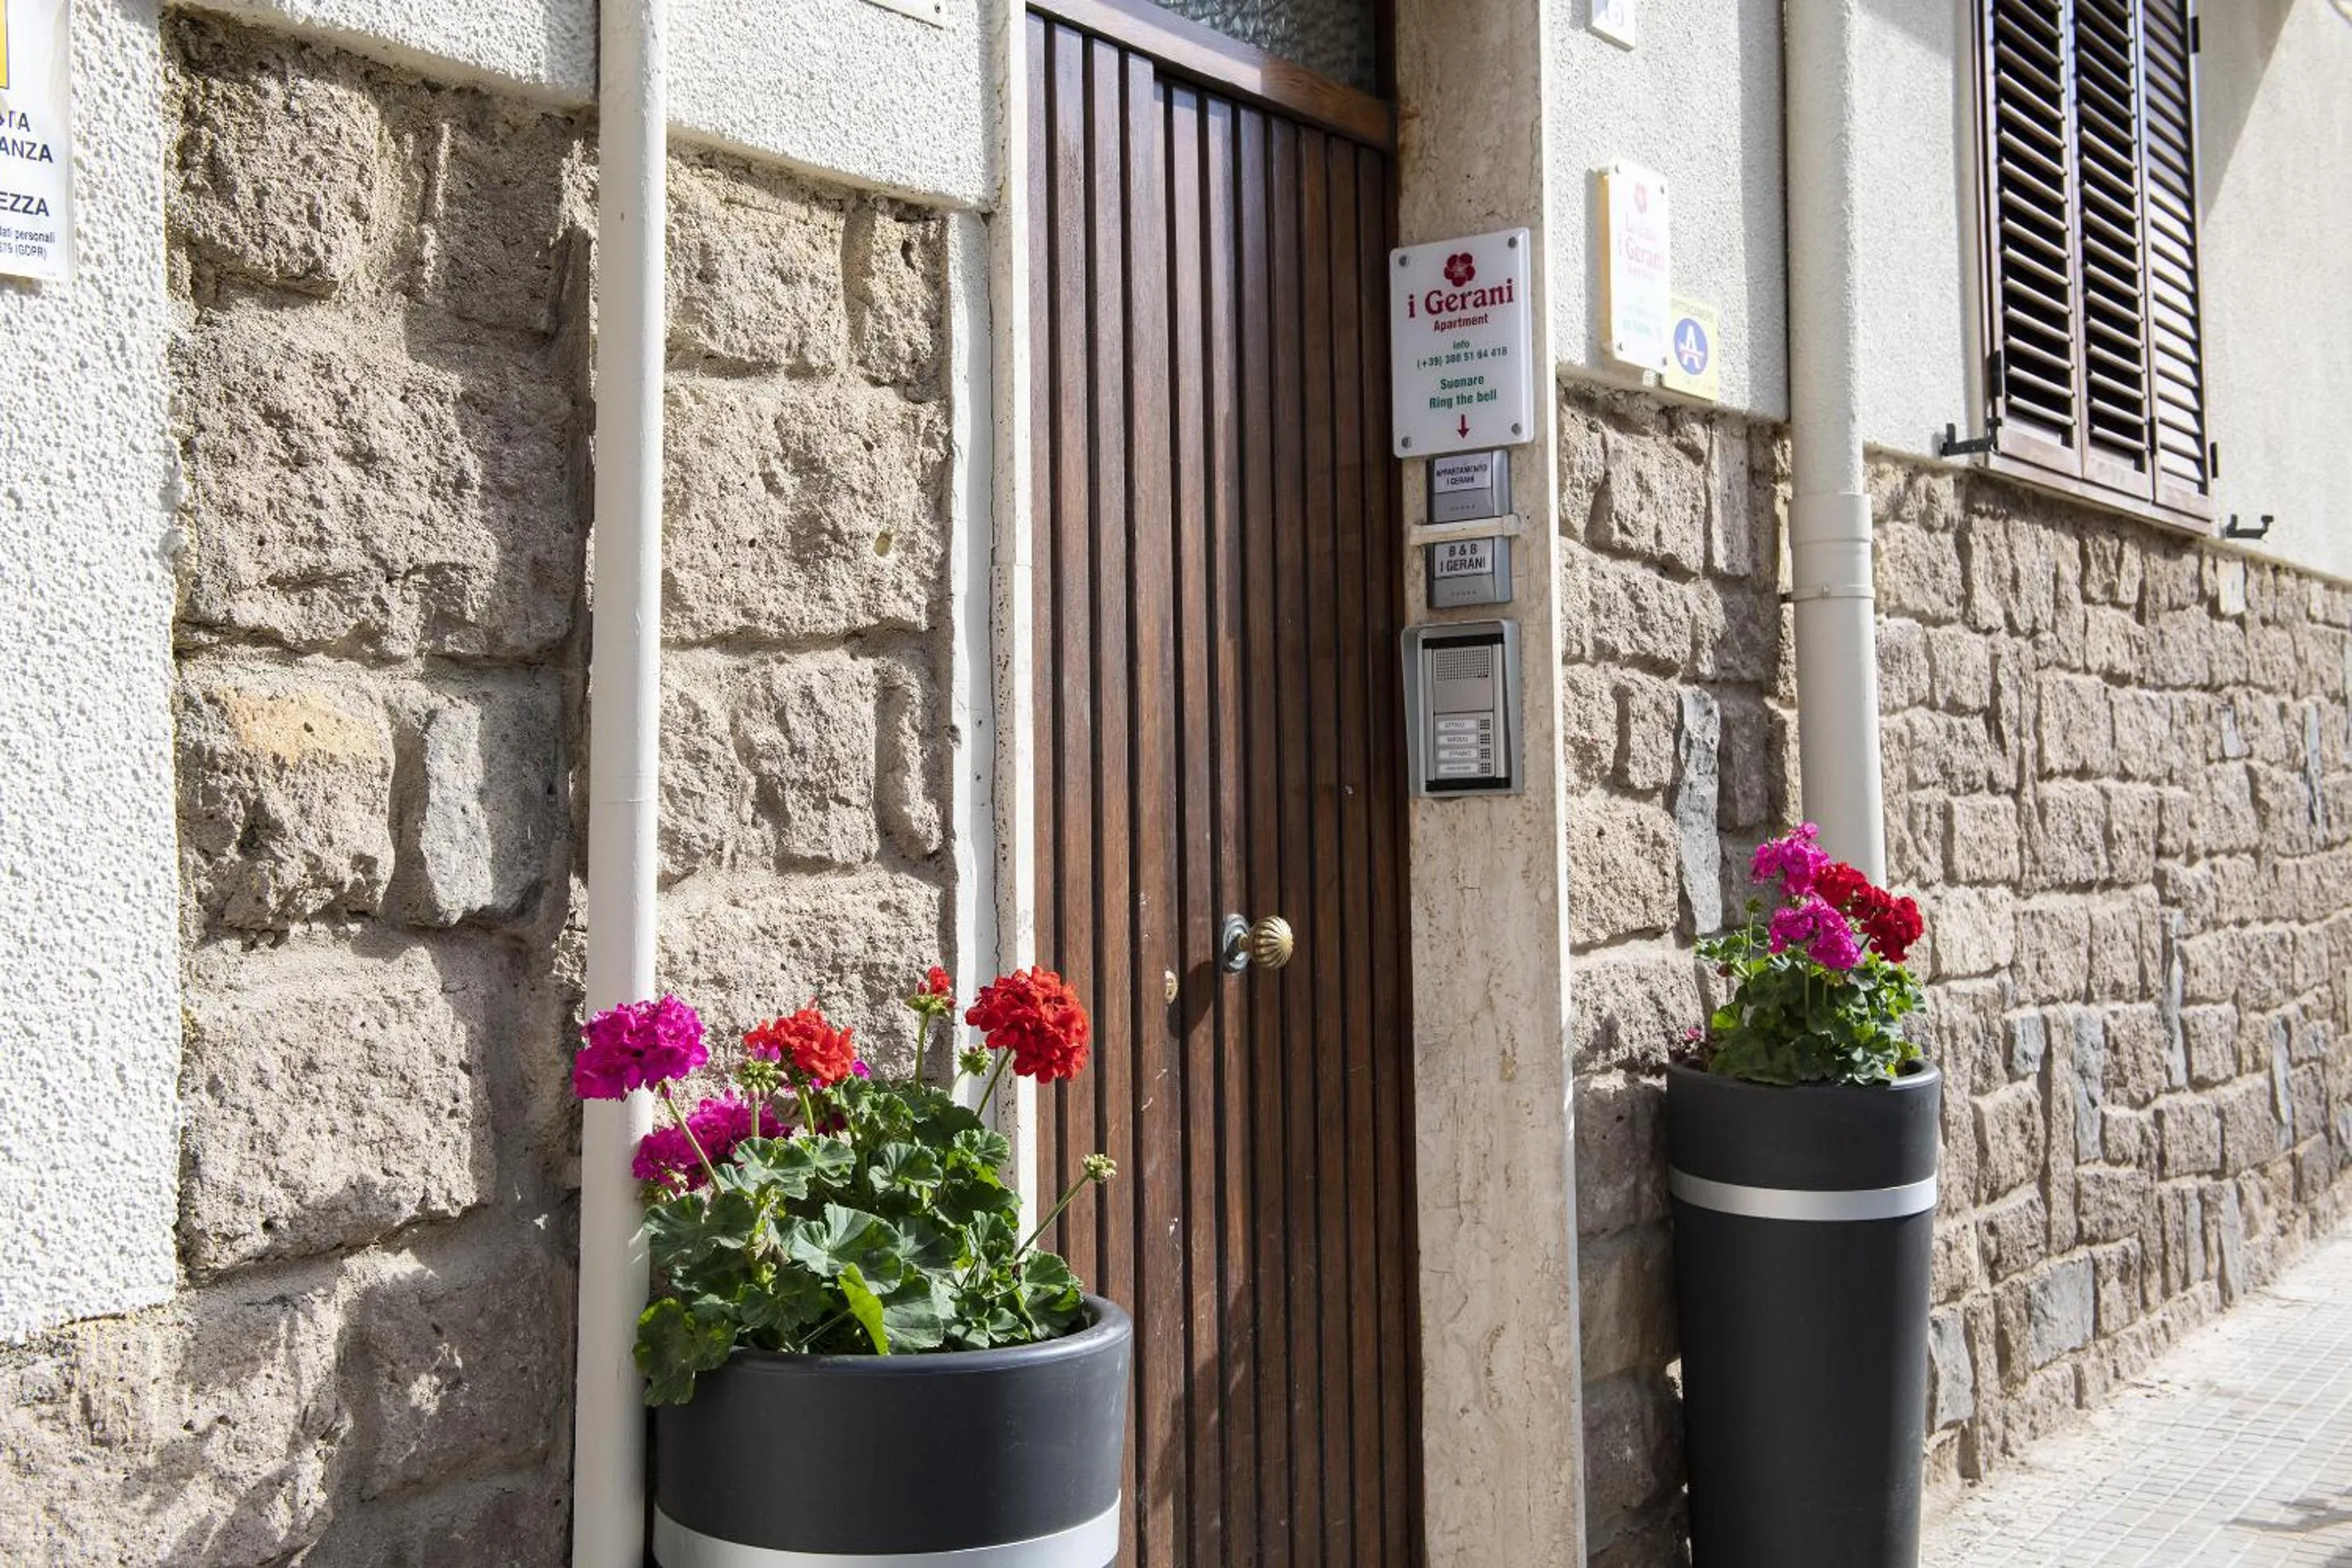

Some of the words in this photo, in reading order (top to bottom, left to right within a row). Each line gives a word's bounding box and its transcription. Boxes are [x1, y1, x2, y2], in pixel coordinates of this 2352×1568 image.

[14, 229, 56, 244] personali
[1408, 294, 1415, 319] i
[1424, 278, 1514, 315] Gerani
[1434, 313, 1489, 332] Apartment
[1440, 375, 1485, 389] Suonare
[1429, 397, 1453, 409] Ring
[1456, 393, 1473, 405] the
[1477, 389, 1497, 402] bell
[1449, 545, 1456, 557] B
[1459, 544, 1467, 556] &
[1470, 543, 1478, 555] B
[1440, 560, 1444, 573] I
[1446, 556, 1486, 572] GERANI
